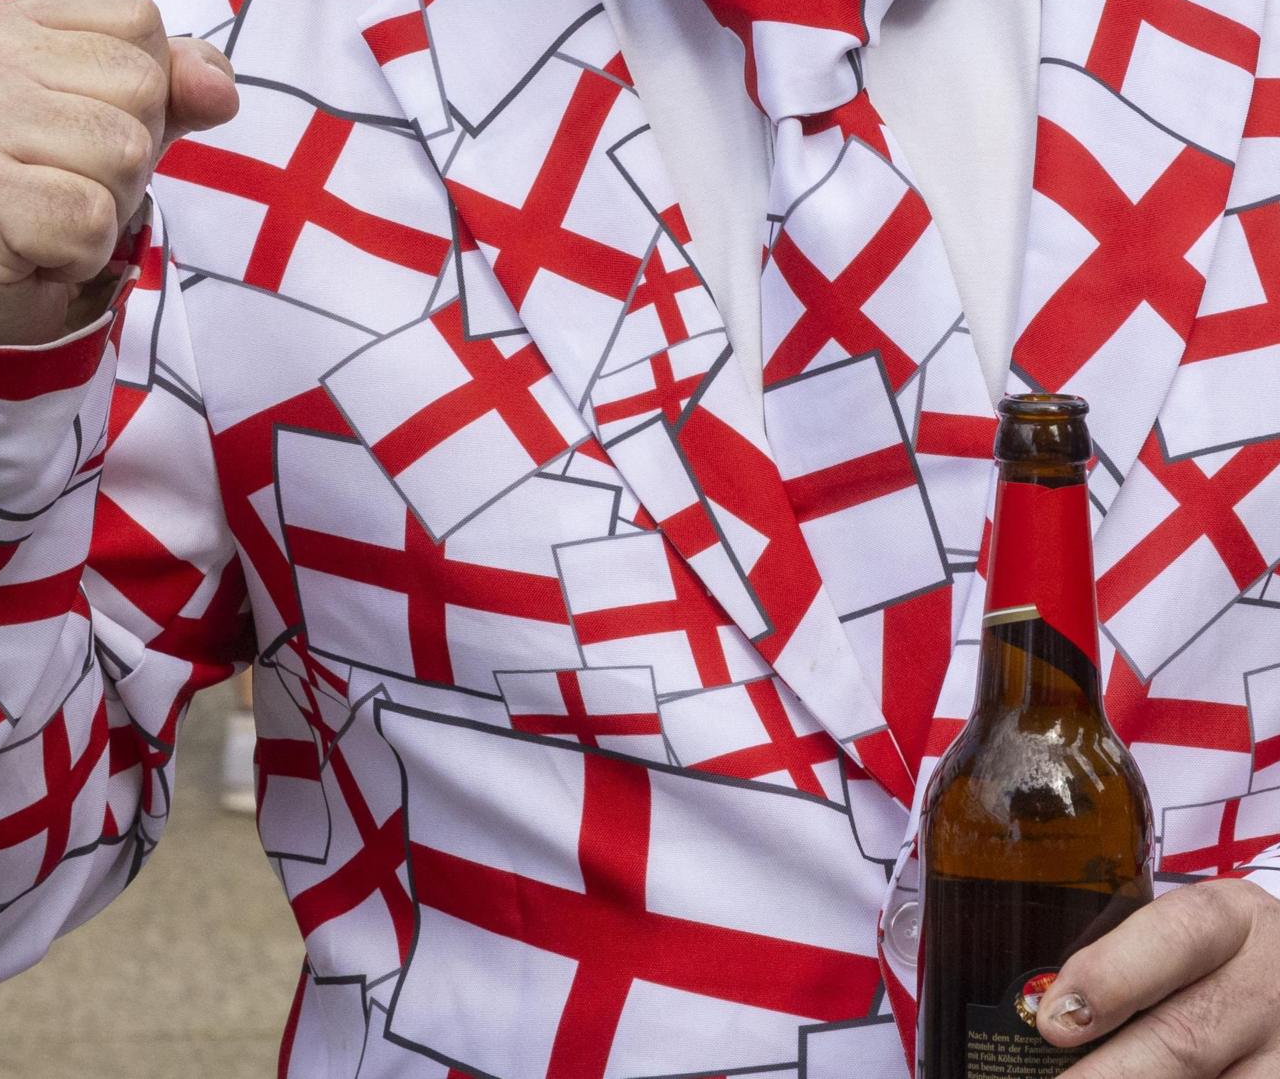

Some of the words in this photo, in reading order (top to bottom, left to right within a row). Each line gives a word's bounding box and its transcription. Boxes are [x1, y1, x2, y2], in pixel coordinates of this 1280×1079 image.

[968, 1030, 988, 1041] Nach
[992, 1033, 1010, 1042] dem
[997, 1043, 1006, 1052] in
[1008, 1043, 1022, 1053] der
[968, 1052, 979, 1060] mit
[980, 1052, 997, 1062] Früh
[998, 1054, 1024, 1063] Kölsch
[981, 1062, 1005, 1072] besten
[1006, 1065, 1037, 1074] Zutaten
[1038, 1066, 1054, 1074] und
